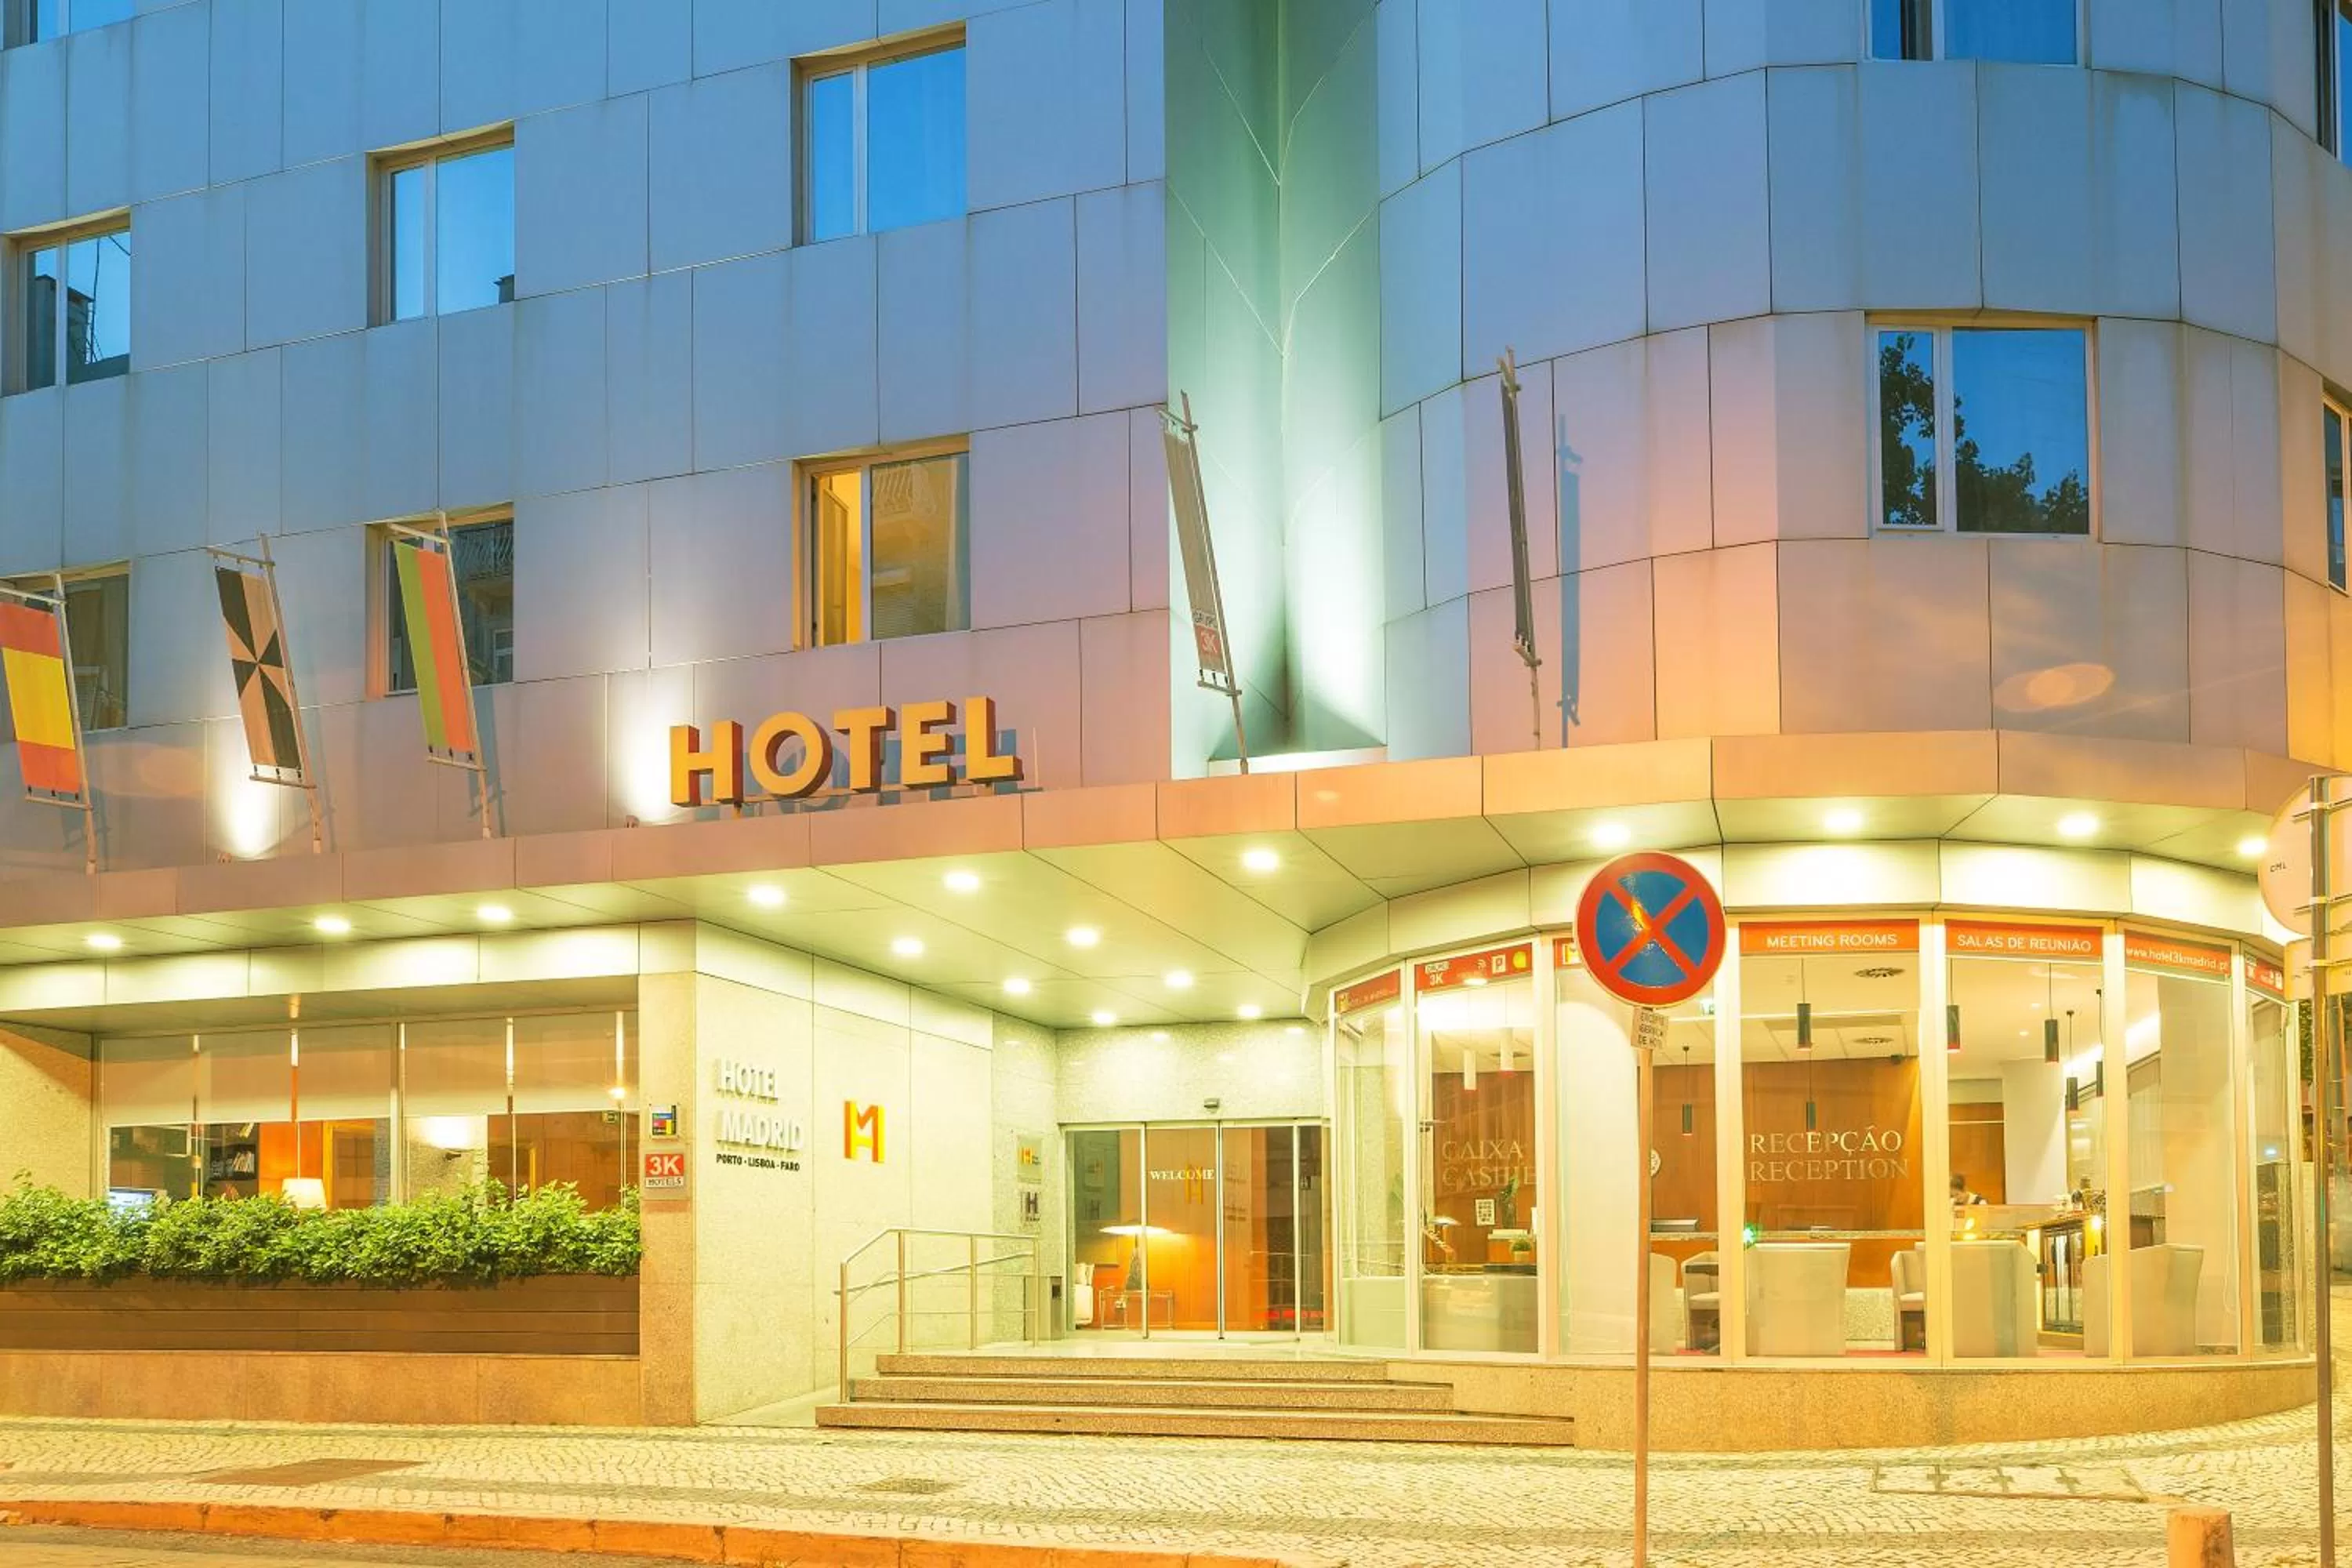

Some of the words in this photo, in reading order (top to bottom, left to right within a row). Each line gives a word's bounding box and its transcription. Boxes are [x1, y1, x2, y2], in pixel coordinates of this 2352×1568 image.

[670, 696, 1022, 806] HOTEL
[1767, 935, 1835, 948] MEETING
[1840, 934, 1897, 946] ROOMS
[1957, 935, 2003, 948] SALAS
[2008, 937, 2026, 949] DE
[1430, 973, 1443, 985] 3K
[720, 1107, 803, 1150] MADRID
[1443, 1140, 1523, 1160] CAIXA
[649, 1156, 680, 1175] 3K
[717, 1154, 742, 1165] PORTO
[748, 1157, 775, 1169] LISBOA
[780, 1161, 800, 1171] FARO
[1750, 1158, 1909, 1181] RECEPTION
[1150, 1168, 1214, 1180] WELCOME
[1443, 1166, 1536, 1186] CASHIE
